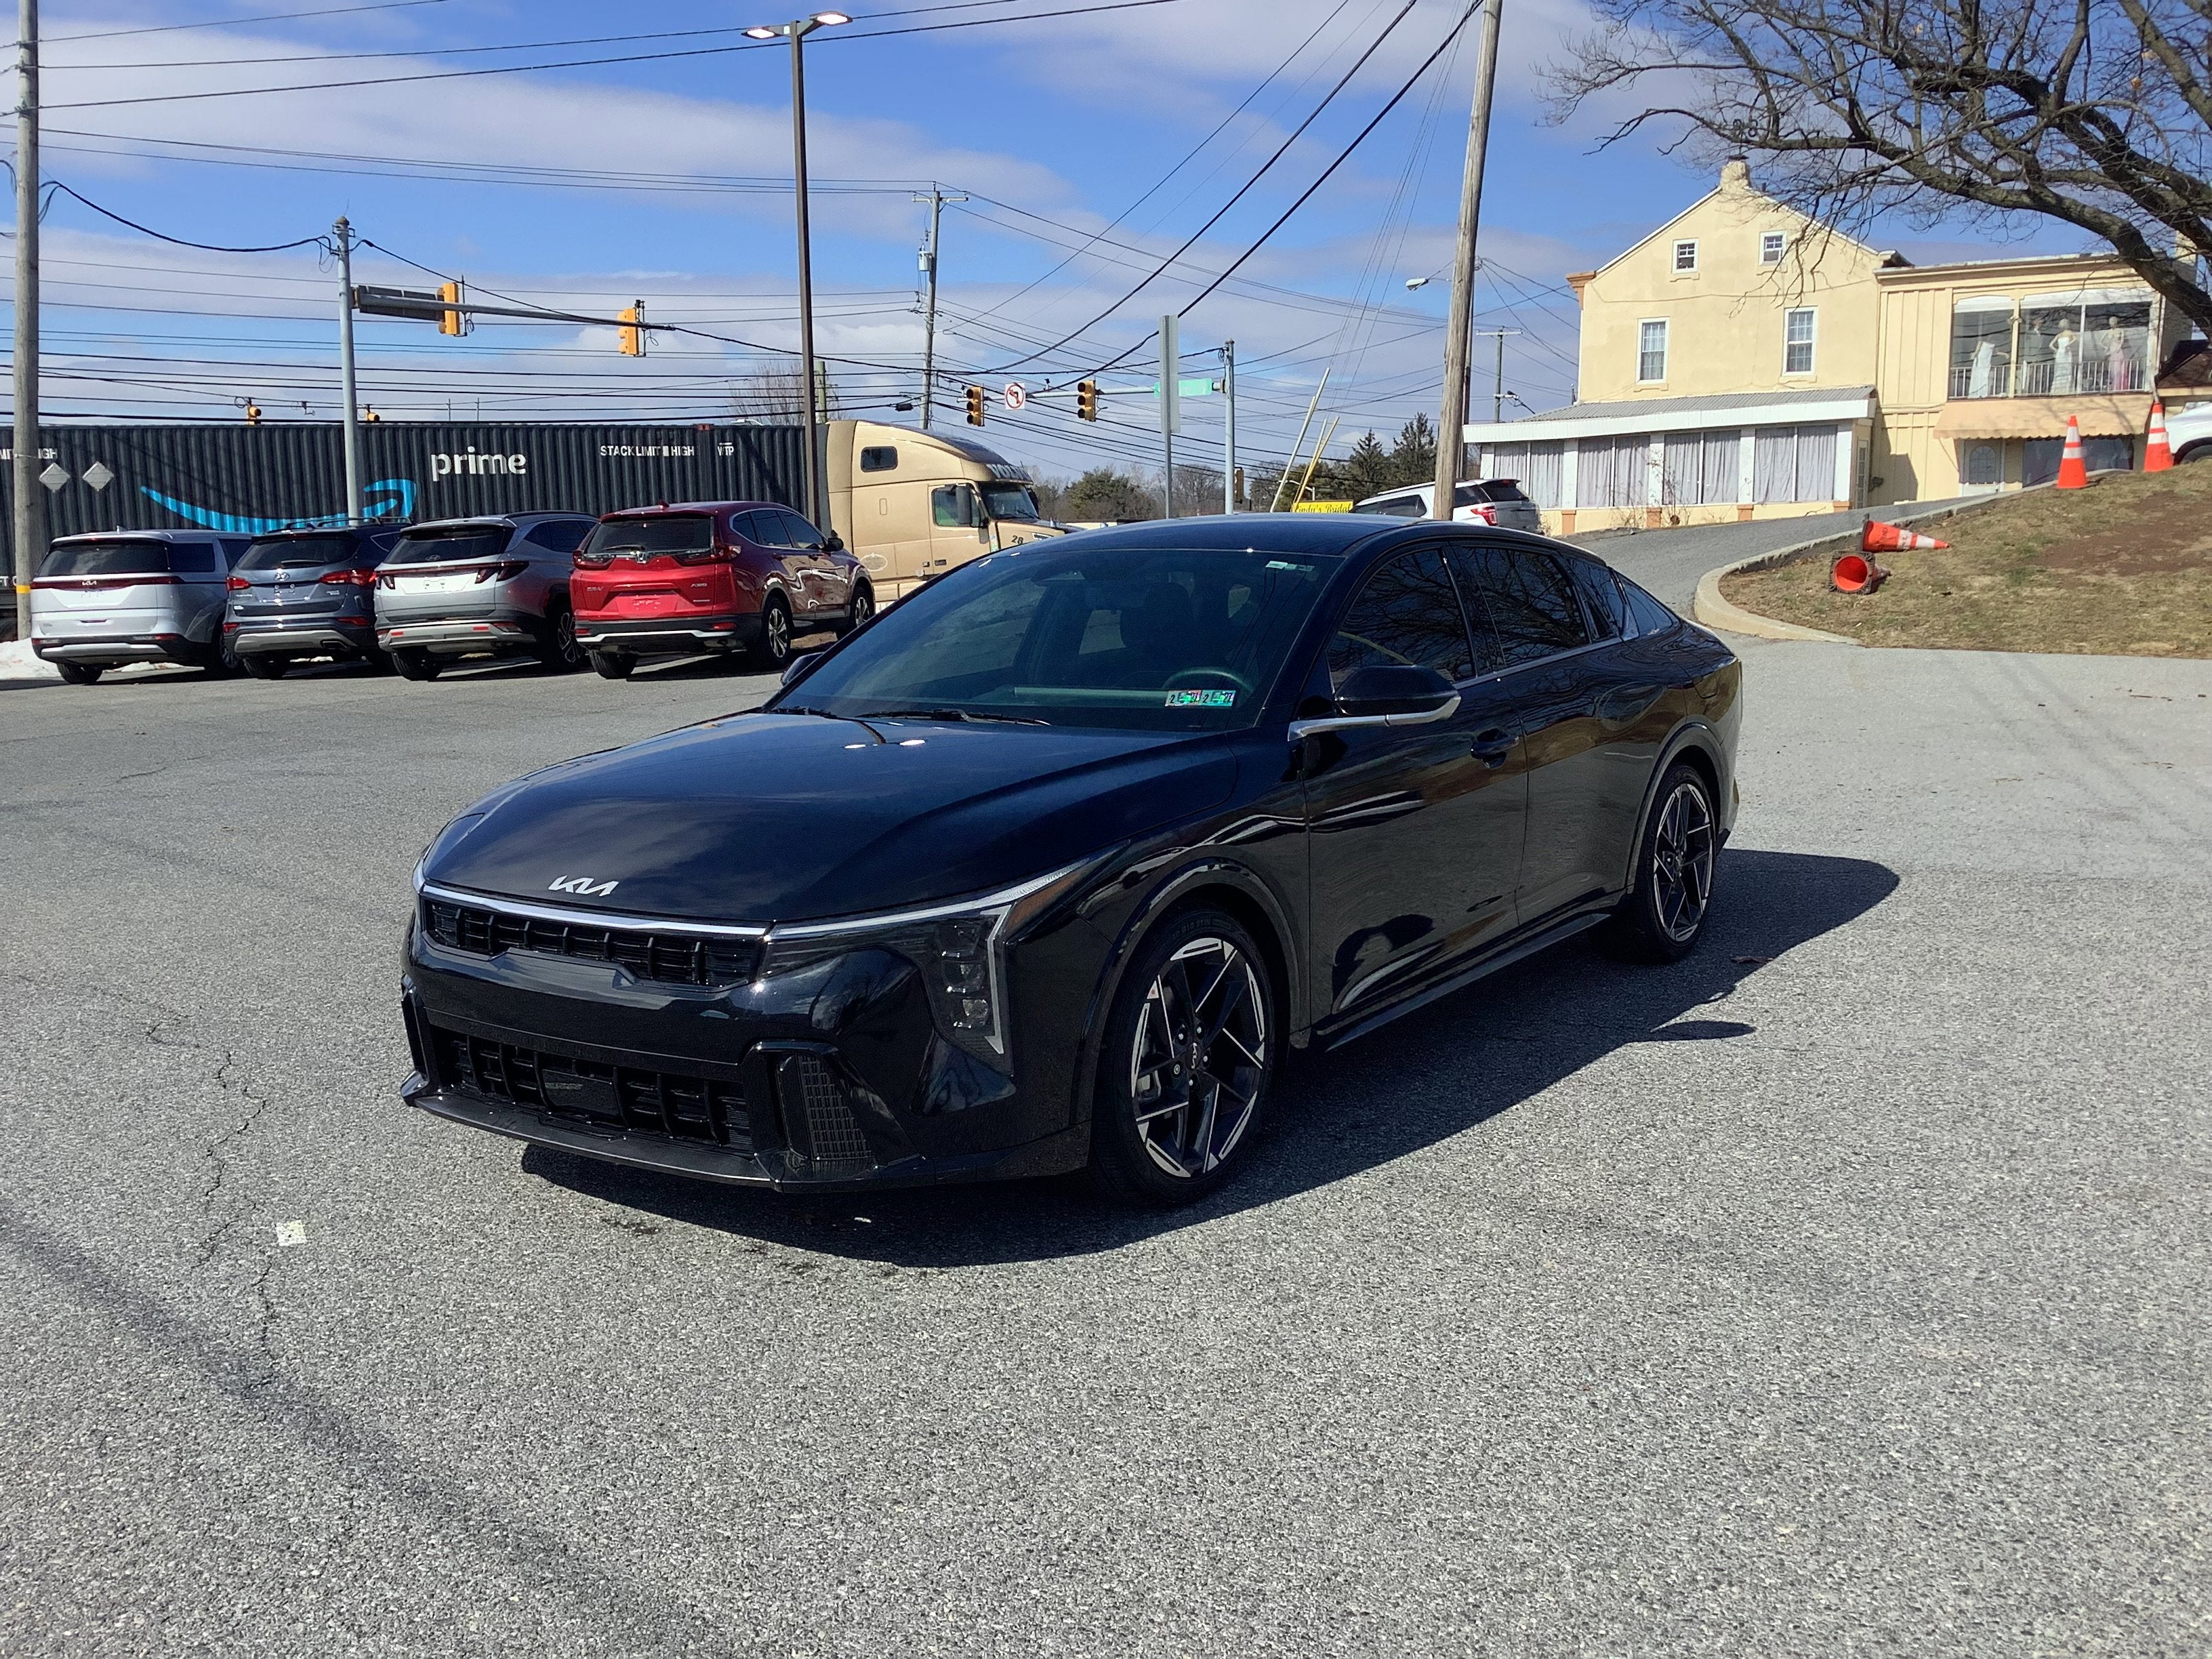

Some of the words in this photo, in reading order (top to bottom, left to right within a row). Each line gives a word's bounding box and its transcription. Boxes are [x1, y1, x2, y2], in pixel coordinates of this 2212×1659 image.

[600, 445, 635, 456] STACK
[636, 445, 661, 456] LIMIT
[671, 445, 695, 456] HIGH
[431, 446, 526, 481] prime
[986, 464, 1031, 480] VOLVO
[1325, 503, 1351, 513] Bridal
[1011, 535, 1024, 544] 28
[548, 875, 619, 897] KIA
